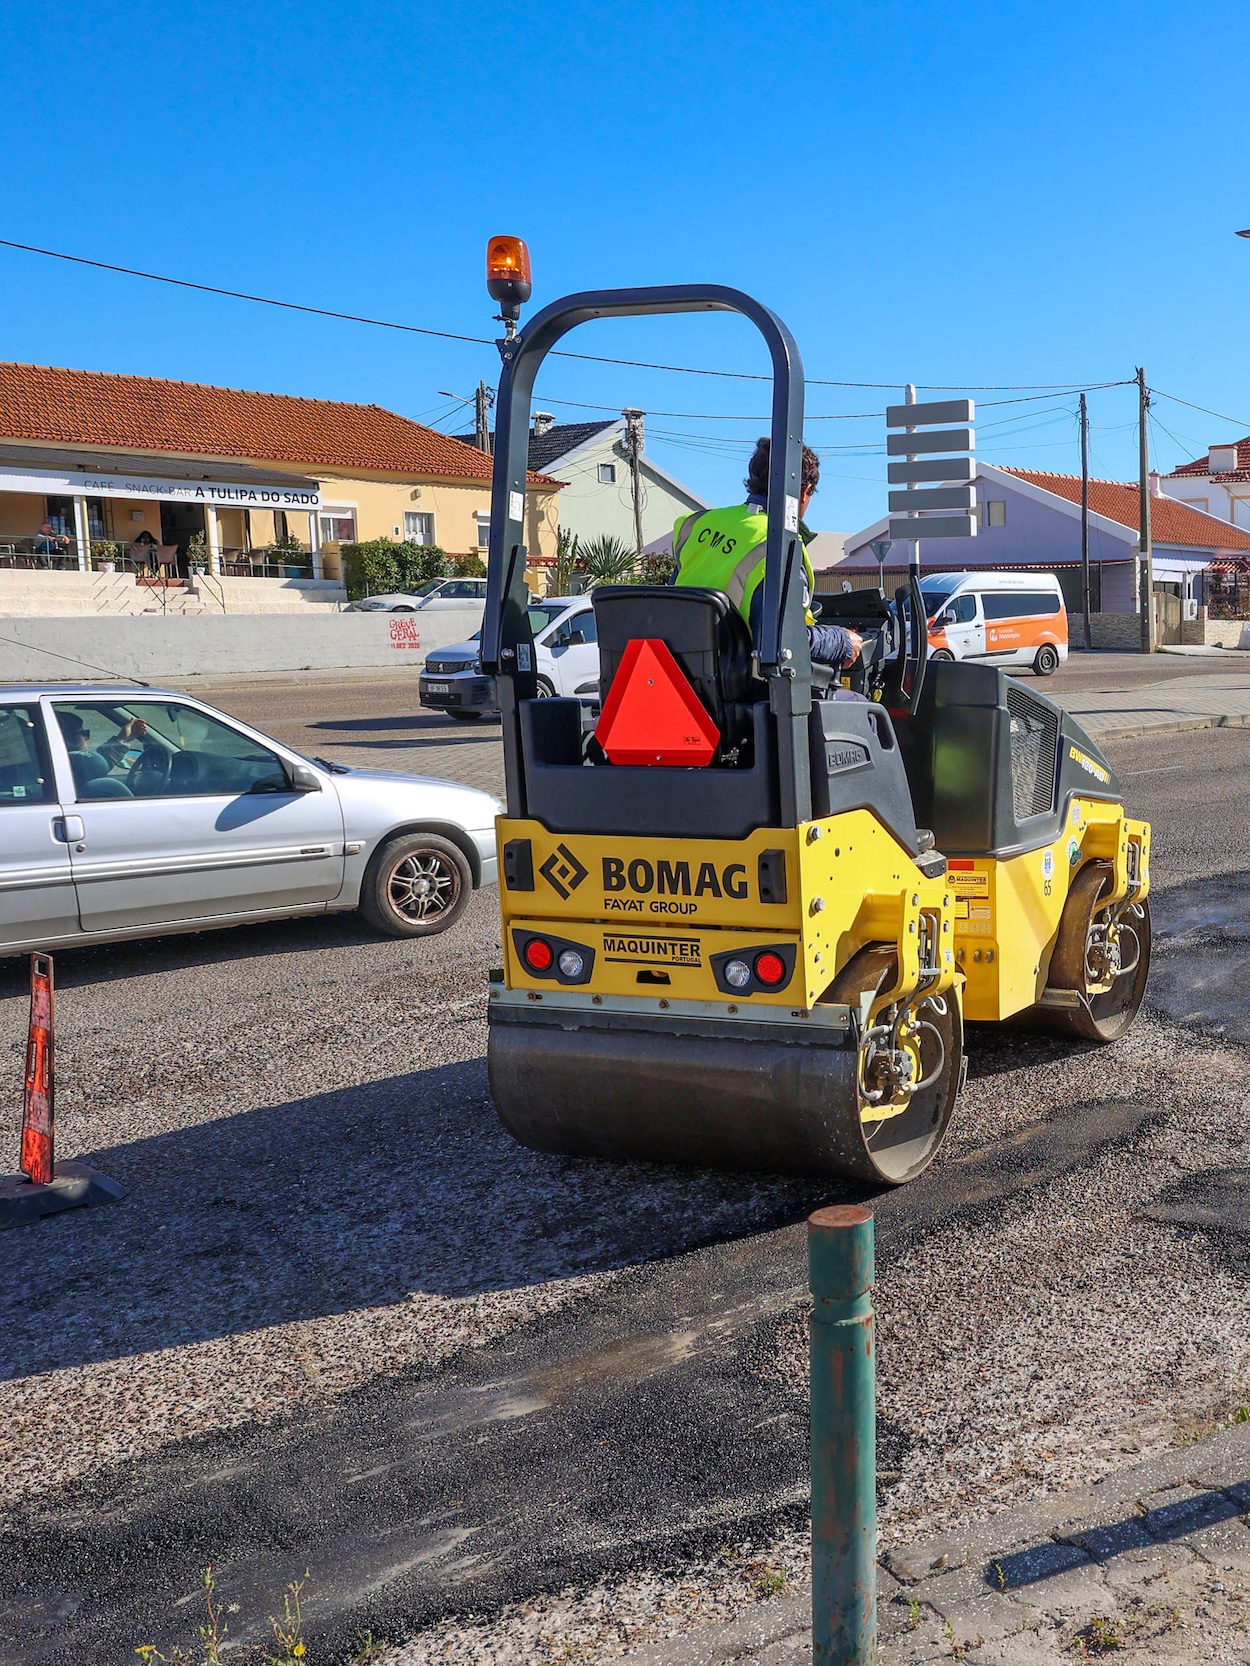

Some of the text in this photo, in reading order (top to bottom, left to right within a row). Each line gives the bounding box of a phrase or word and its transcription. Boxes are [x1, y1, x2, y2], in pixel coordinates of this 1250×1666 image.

[84, 480, 319, 505] CAFÉ SNACK-BAR A TULIPA DO SADO
[389, 618, 417, 630] GREVE
[390, 628, 420, 641] GERAL
[602, 857, 748, 899] BOMAG
[1044, 880, 1052, 896] 65
[604, 898, 698, 915] FAYAT GROUP
[603, 938, 701, 957] MAQUINTER
